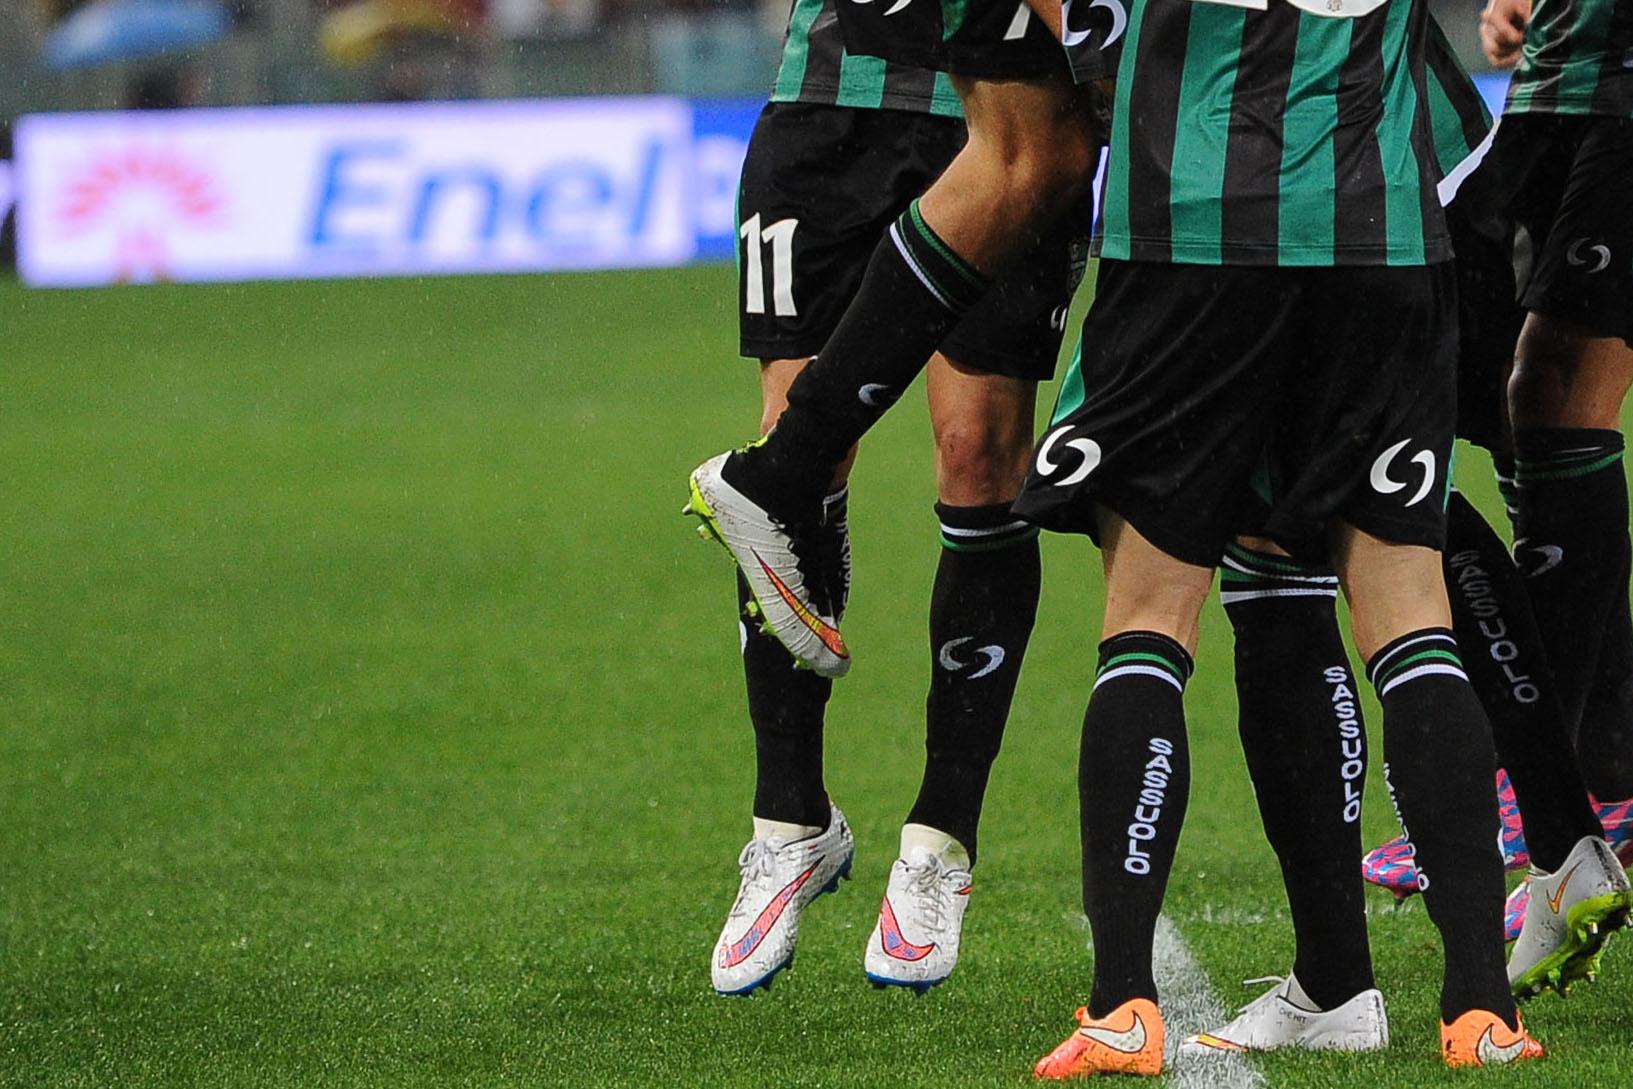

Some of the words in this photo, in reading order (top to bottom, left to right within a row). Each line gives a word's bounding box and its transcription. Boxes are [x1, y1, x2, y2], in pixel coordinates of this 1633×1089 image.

[308, 134, 664, 254] Enel
[739, 211, 799, 317] 11
[1450, 549, 1541, 704] SASSUOLO
[1124, 737, 1174, 876] SASSUOLO
[1323, 666, 1361, 824] SASSUOLO
